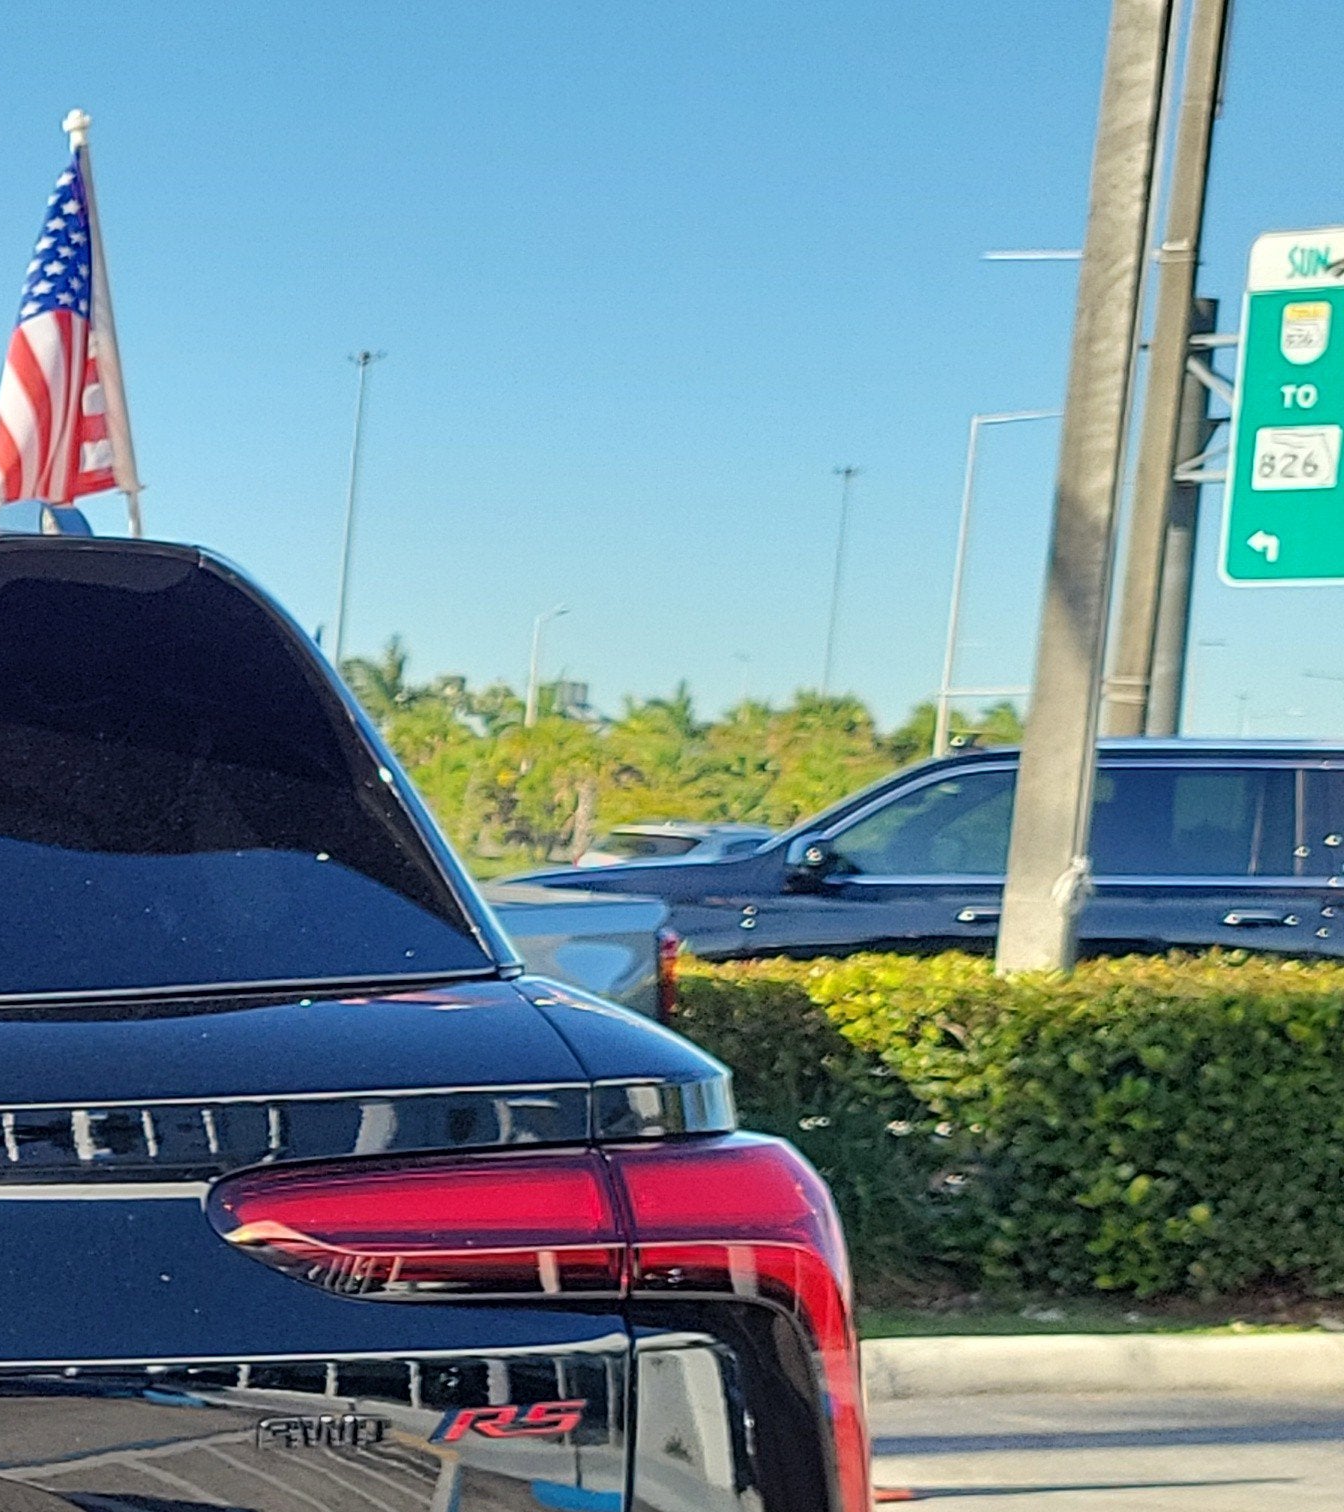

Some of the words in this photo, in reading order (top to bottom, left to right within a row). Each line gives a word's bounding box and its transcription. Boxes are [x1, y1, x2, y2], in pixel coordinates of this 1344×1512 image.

[1279, 383, 1319, 409] TO
[1258, 449, 1319, 478] 826
[428, 1399, 587, 1442] RS
